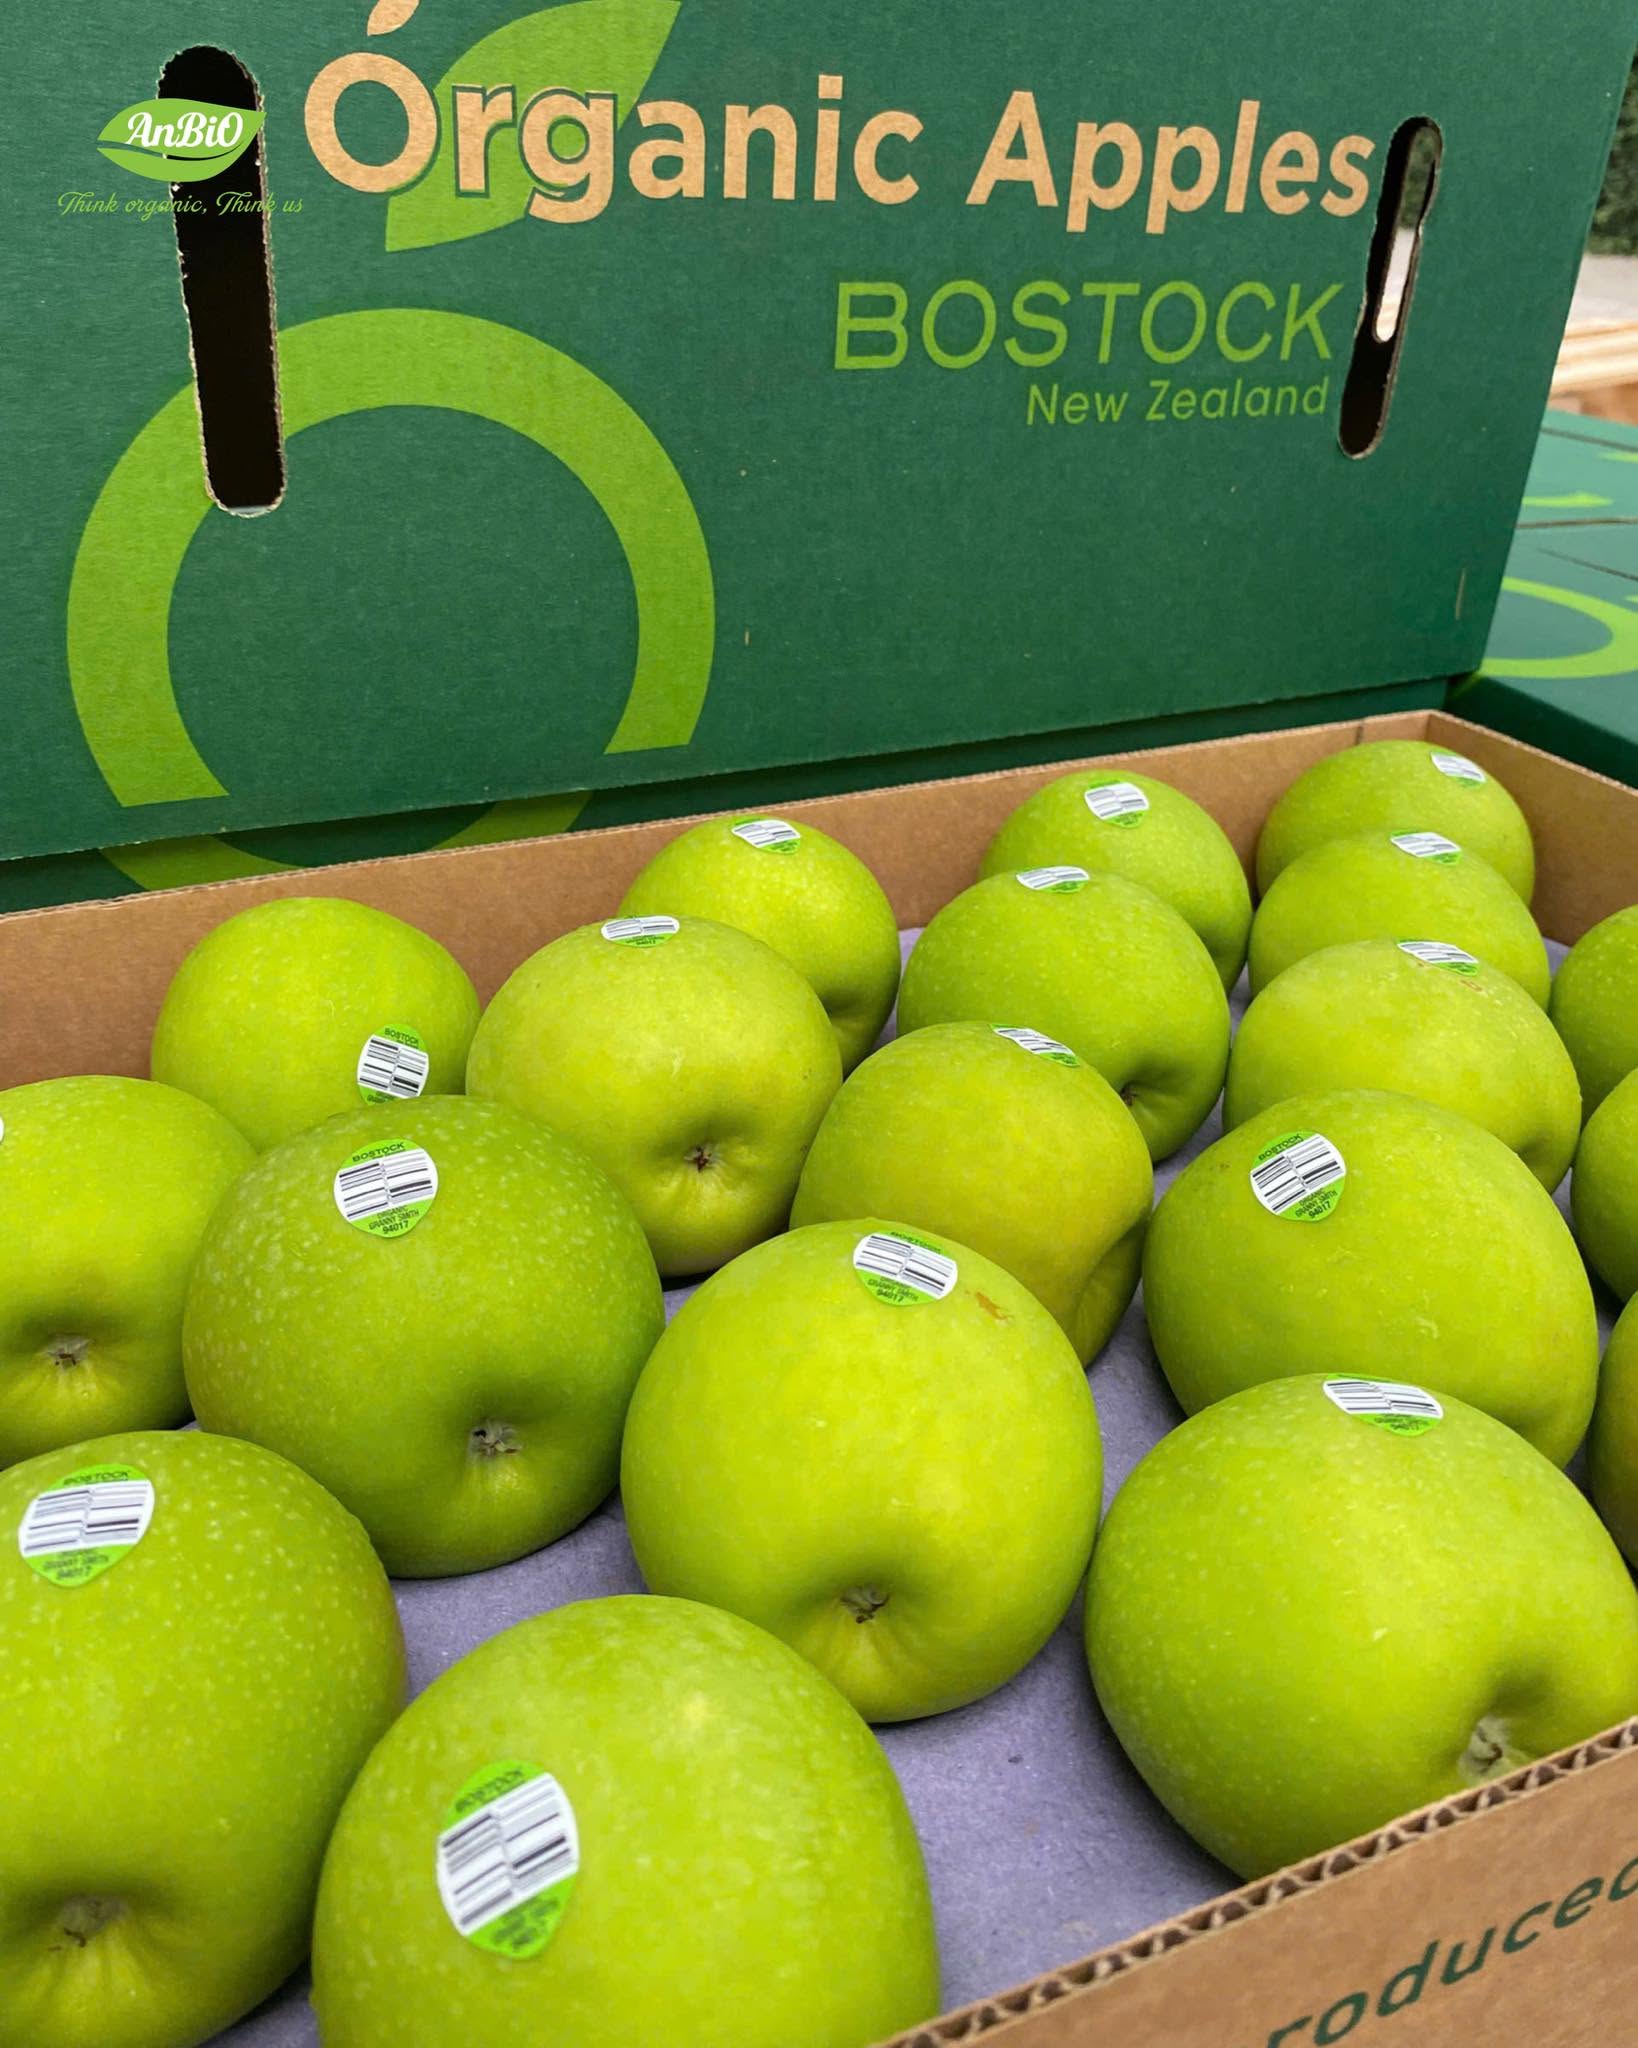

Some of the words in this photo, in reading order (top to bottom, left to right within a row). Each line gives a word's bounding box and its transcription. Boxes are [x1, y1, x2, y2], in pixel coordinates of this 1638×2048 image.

[304, 52, 924, 224] Organic
[965, 90, 1376, 235] Apples
[833, 279, 1344, 371] BOSTOCK
[1026, 382, 1127, 426] New
[1145, 375, 1331, 422] Zealand
[352, 1142, 405, 1163] BOSTOCK
[1258, 1133, 1305, 1161] BOSTOCK
[1308, 1200, 1332, 1219] 94017
[369, 1214, 398, 1230] GRANNY
[382, 1220, 410, 1235] 94017
